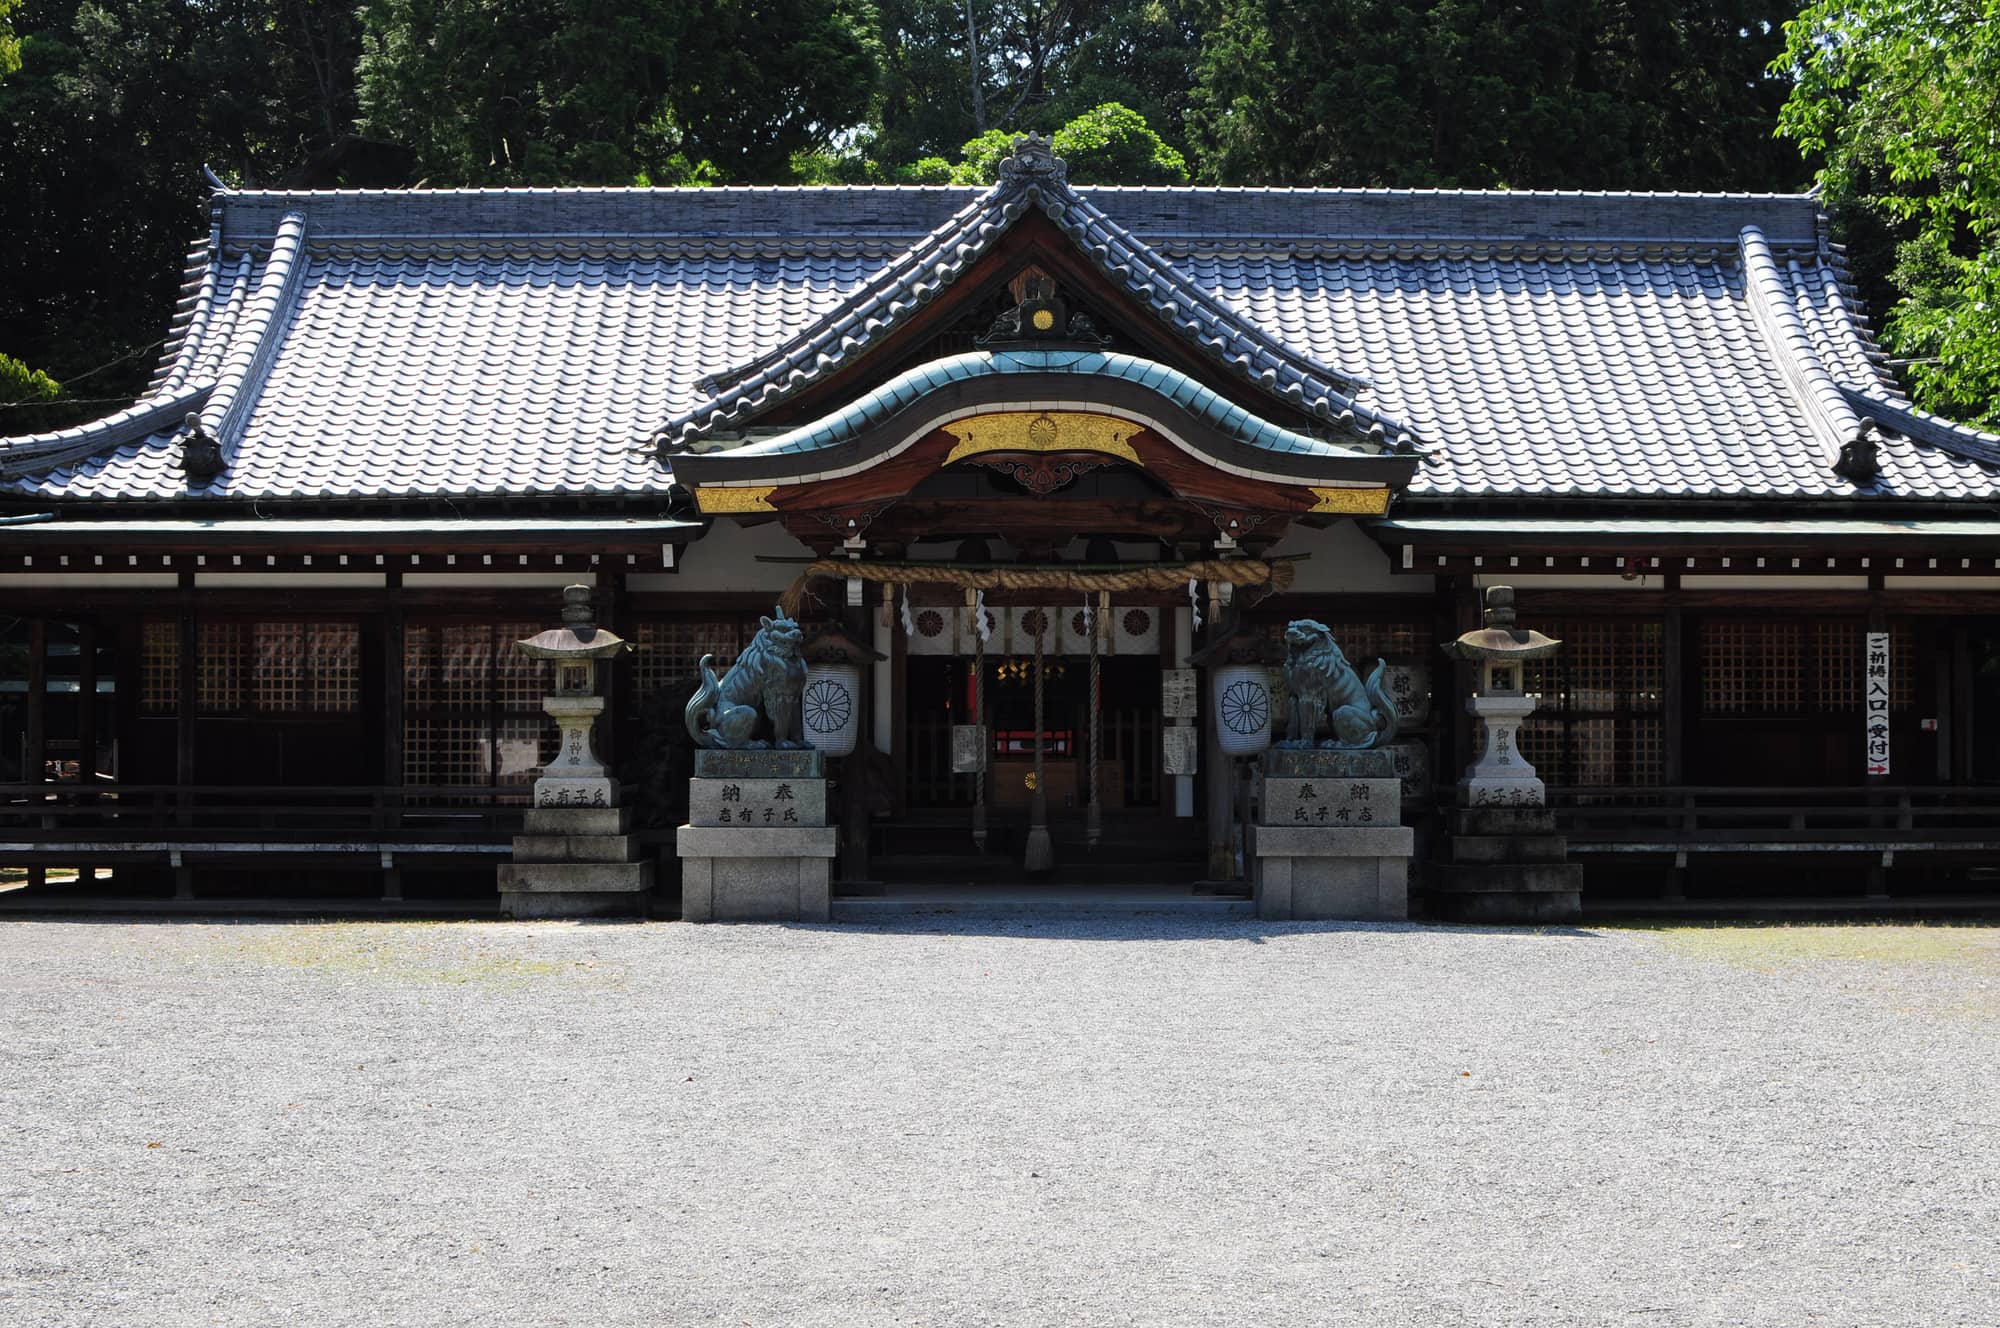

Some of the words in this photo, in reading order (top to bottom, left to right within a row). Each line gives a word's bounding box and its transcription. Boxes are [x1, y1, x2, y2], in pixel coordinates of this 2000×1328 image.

[1298, 783, 1370, 802] 奉納
[1294, 807, 1373, 822] 氏子有志
